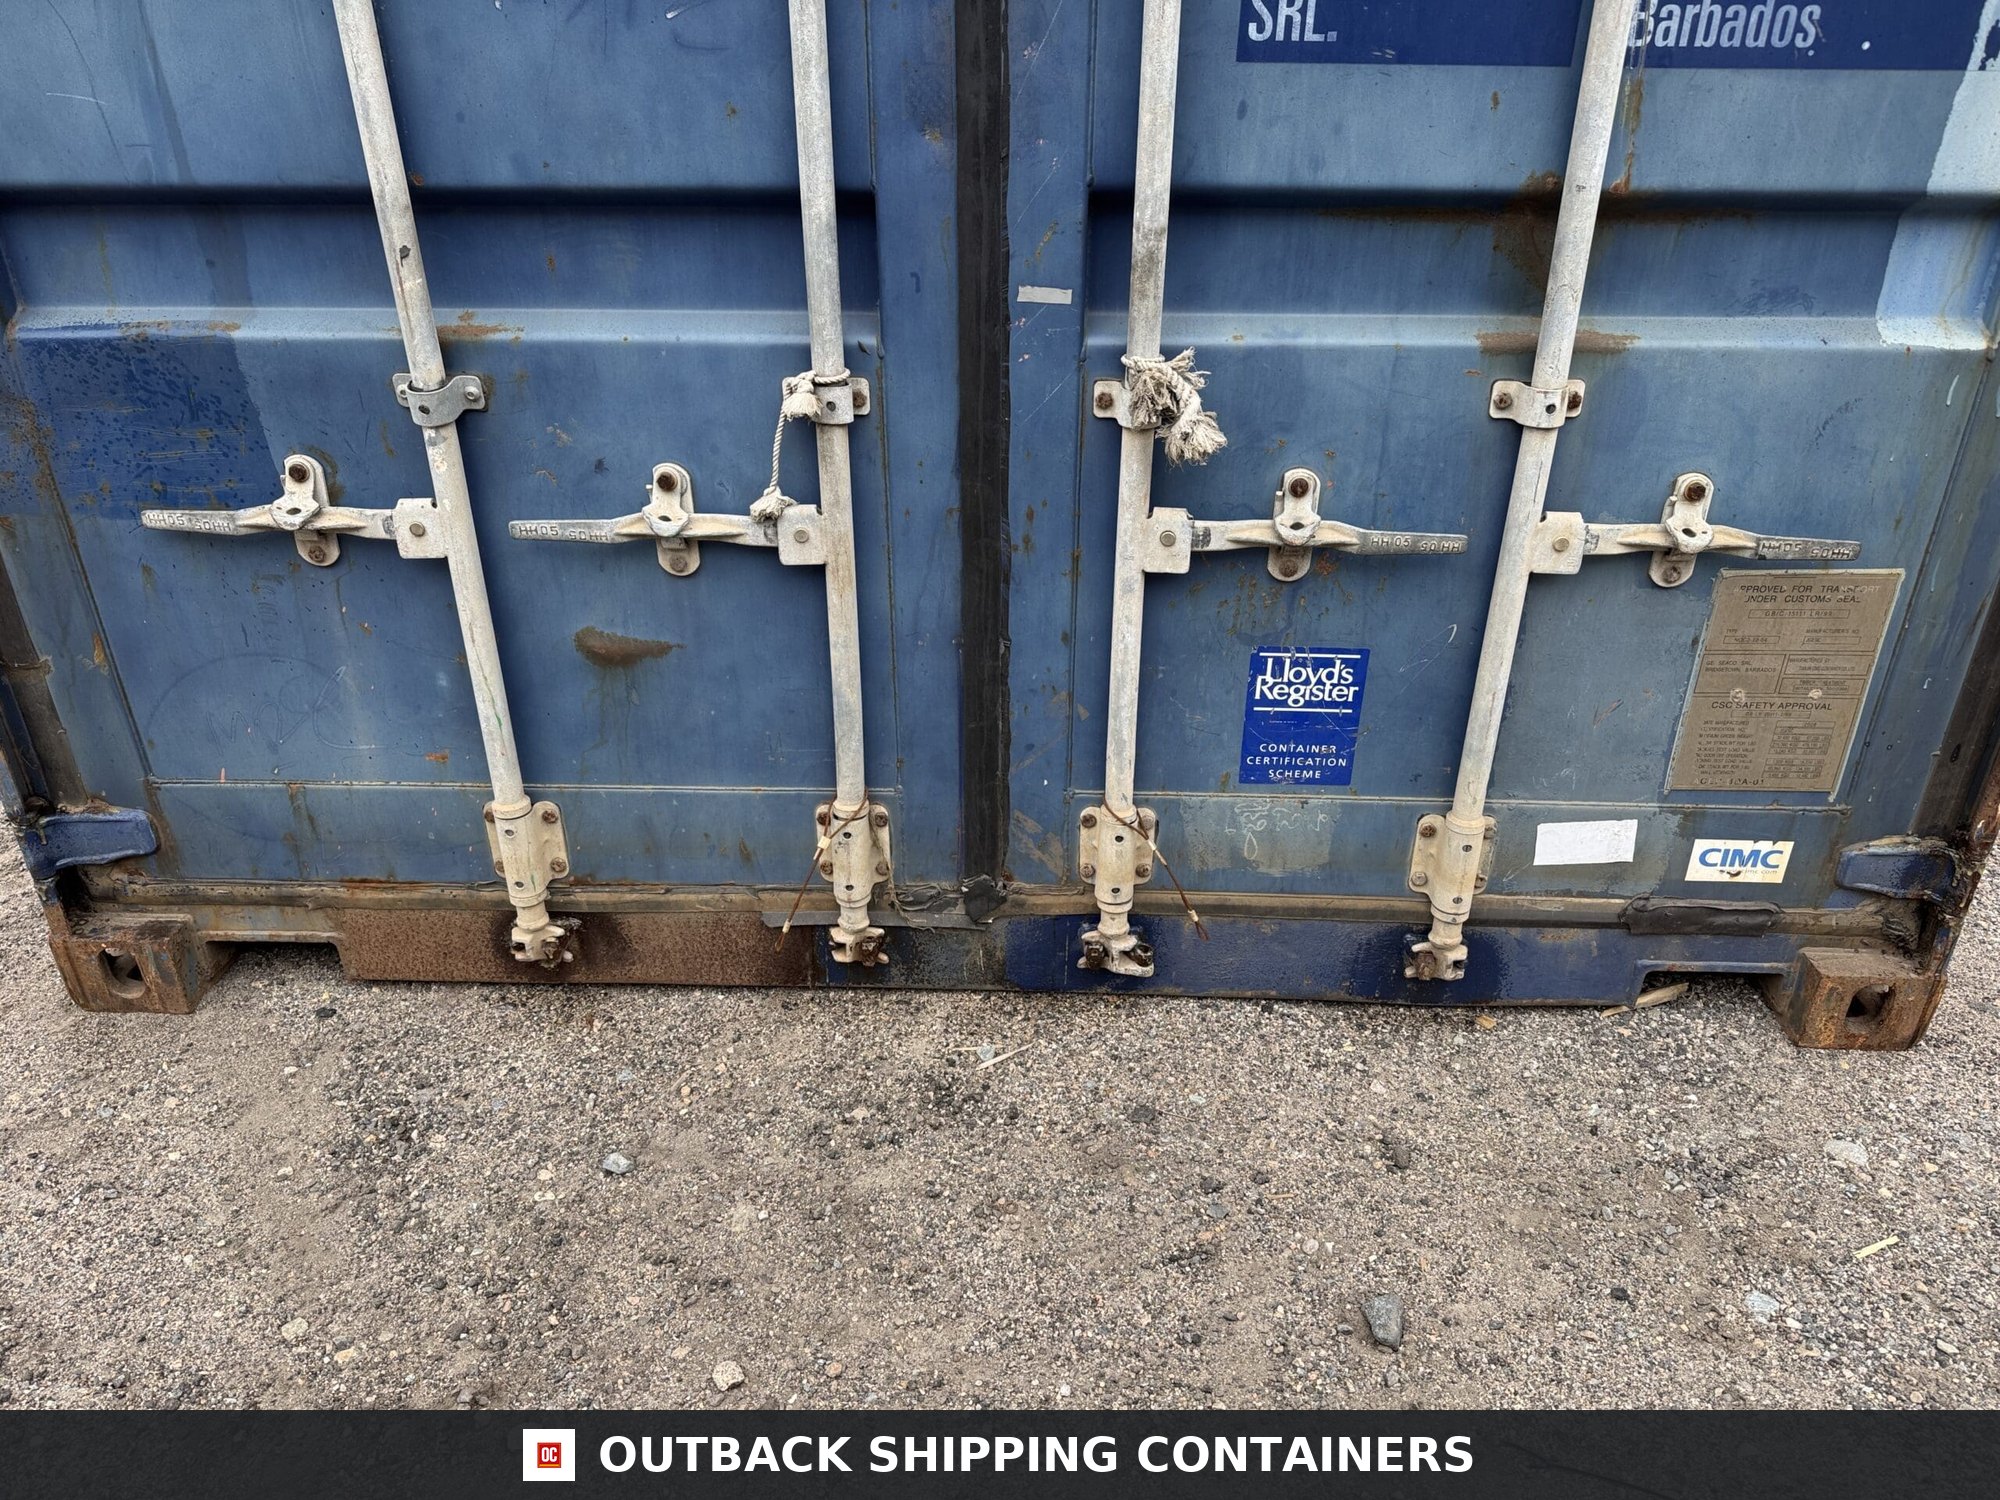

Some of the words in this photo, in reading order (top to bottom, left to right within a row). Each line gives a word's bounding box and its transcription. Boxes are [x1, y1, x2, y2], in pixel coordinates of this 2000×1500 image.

[1248, 0, 1338, 42] SRL.
[1627, 0, 1822, 48] Barbados
[518, 525, 559, 537] HH05
[1791, 585, 1813, 593] FOR
[1784, 594, 1832, 604] CUSTOMS
[1266, 657, 1354, 685] Lloyd's
[1254, 676, 1359, 707] Register
[1711, 701, 1734, 709] CSC
[1735, 701, 1775, 710] SAFETY
[1777, 702, 1833, 711] APPROVAL
[1259, 743, 1337, 754] CONTAINER
[1246, 756, 1347, 767] CERTIFICATION
[1268, 769, 1322, 779] SCHEME
[1699, 848, 1784, 869] CIMC
